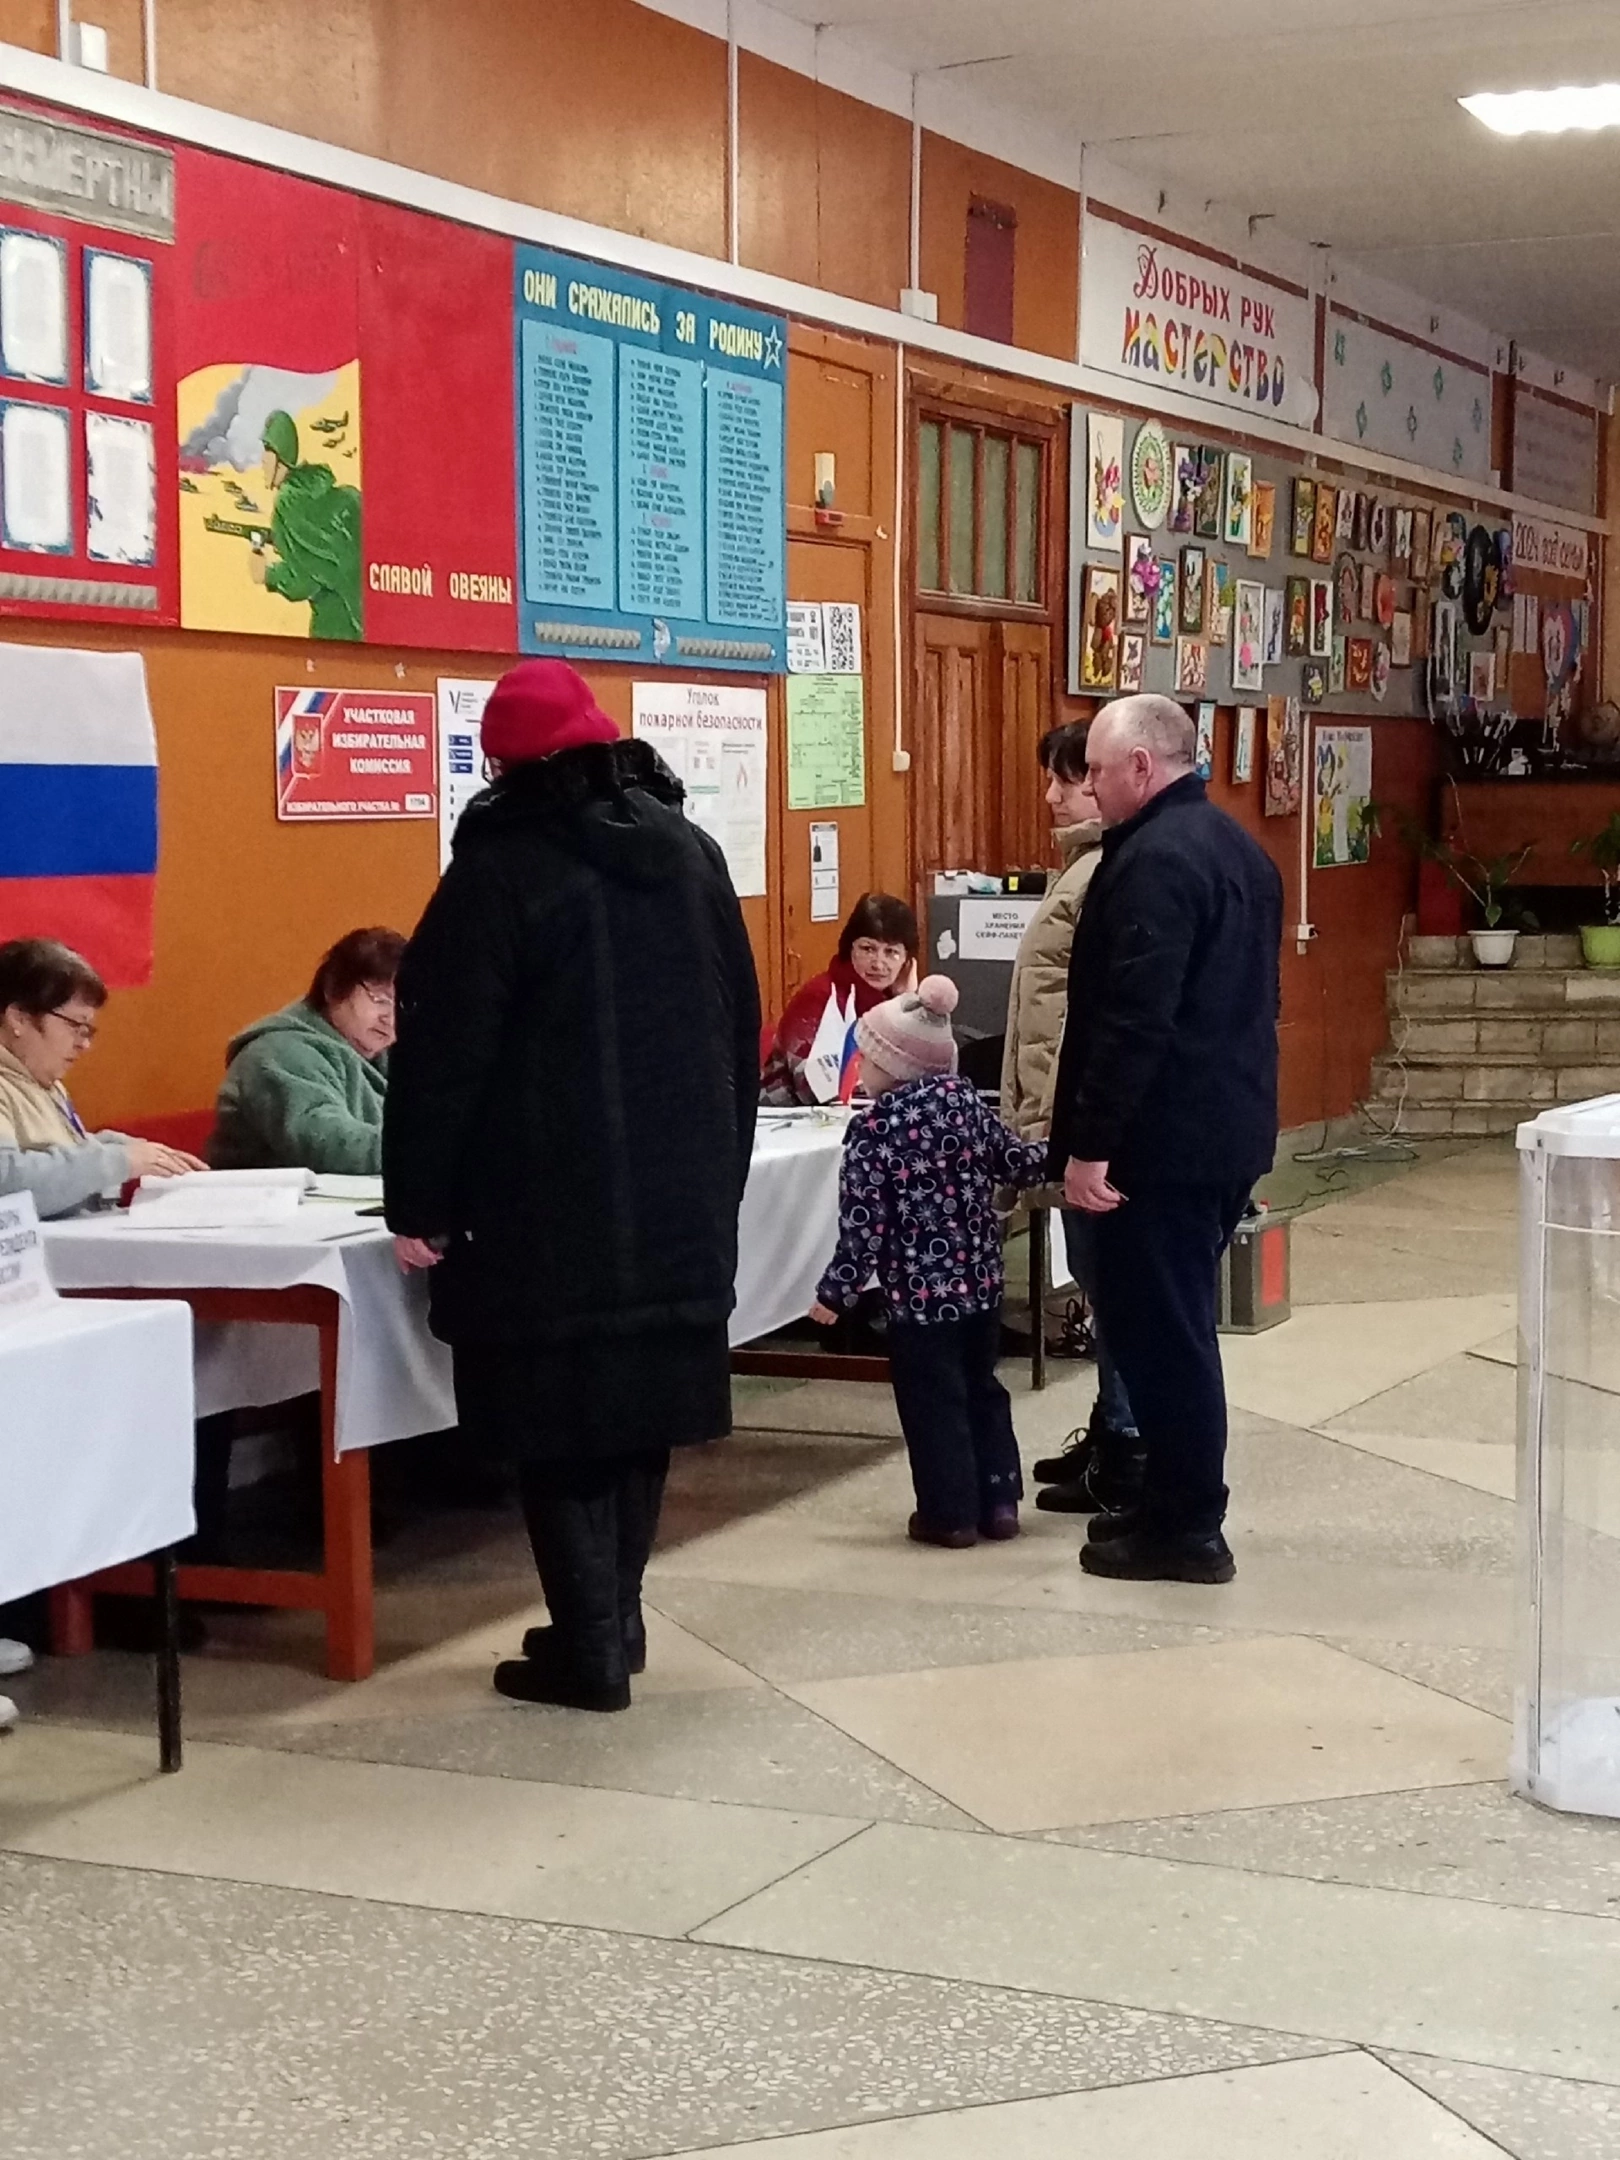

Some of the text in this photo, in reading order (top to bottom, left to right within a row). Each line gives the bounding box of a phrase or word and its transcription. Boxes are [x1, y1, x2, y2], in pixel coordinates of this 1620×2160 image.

[523, 269, 762, 361] ОНИ СРАЖАЛИСЬ ЗА РОДИНУ
[1241, 295, 1275, 339] РУК
[369, 562, 513, 605] СЛАВОЙ ОВЕЯНЫ
[343, 707, 415, 725] УЧАСТКОВАЯ
[332, 732, 426, 749] ИЗБИРАТЕЛЬНАЯ
[350, 757, 411, 774] КОМИССИЯ
